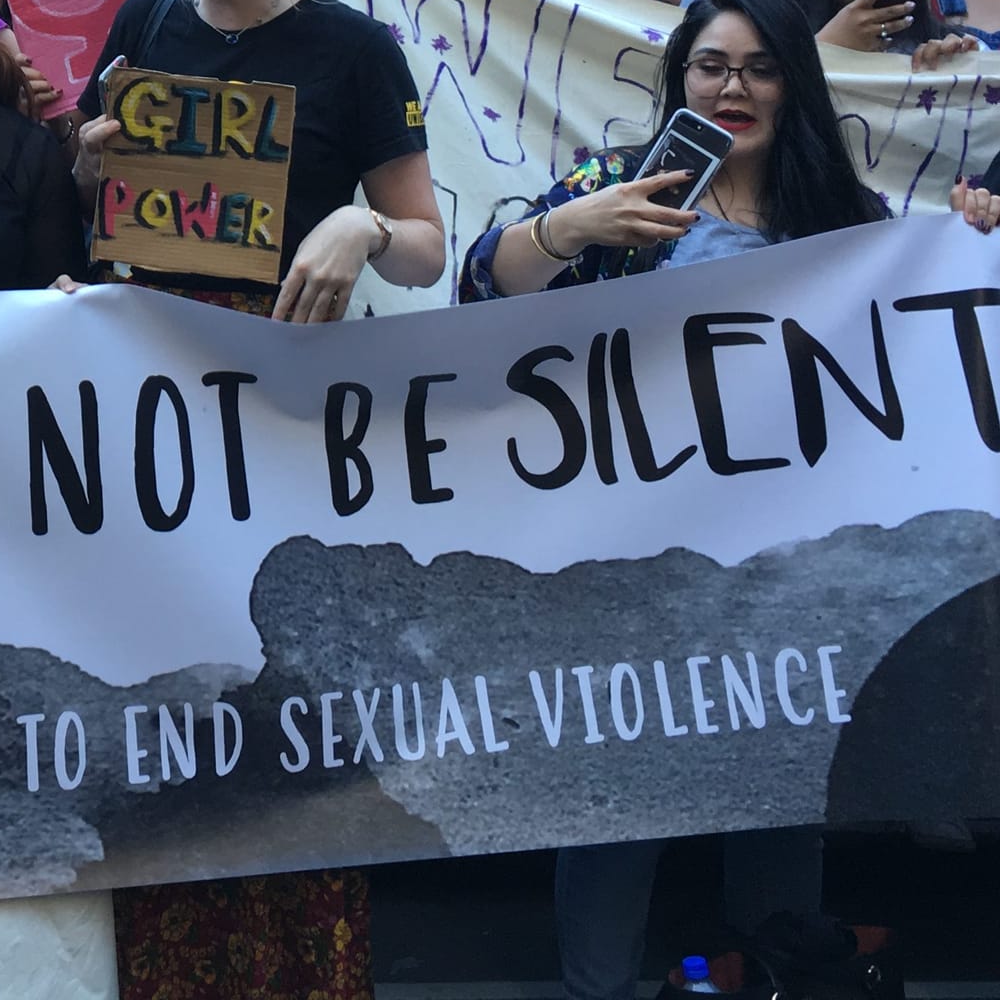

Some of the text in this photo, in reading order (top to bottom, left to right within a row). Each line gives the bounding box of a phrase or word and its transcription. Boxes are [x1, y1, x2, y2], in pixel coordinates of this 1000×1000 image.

[112, 76, 290, 163] GIRL
[99, 176, 280, 252] POWER
[26, 370, 259, 536] NOT
[324, 372, 459, 517] BE
[506, 287, 1000, 492] SILENT
[16, 709, 87, 793] TO
[123, 701, 245, 786] END
[279, 674, 511, 775] SEXUAL
[529, 644, 853, 749] VIOLENCE
